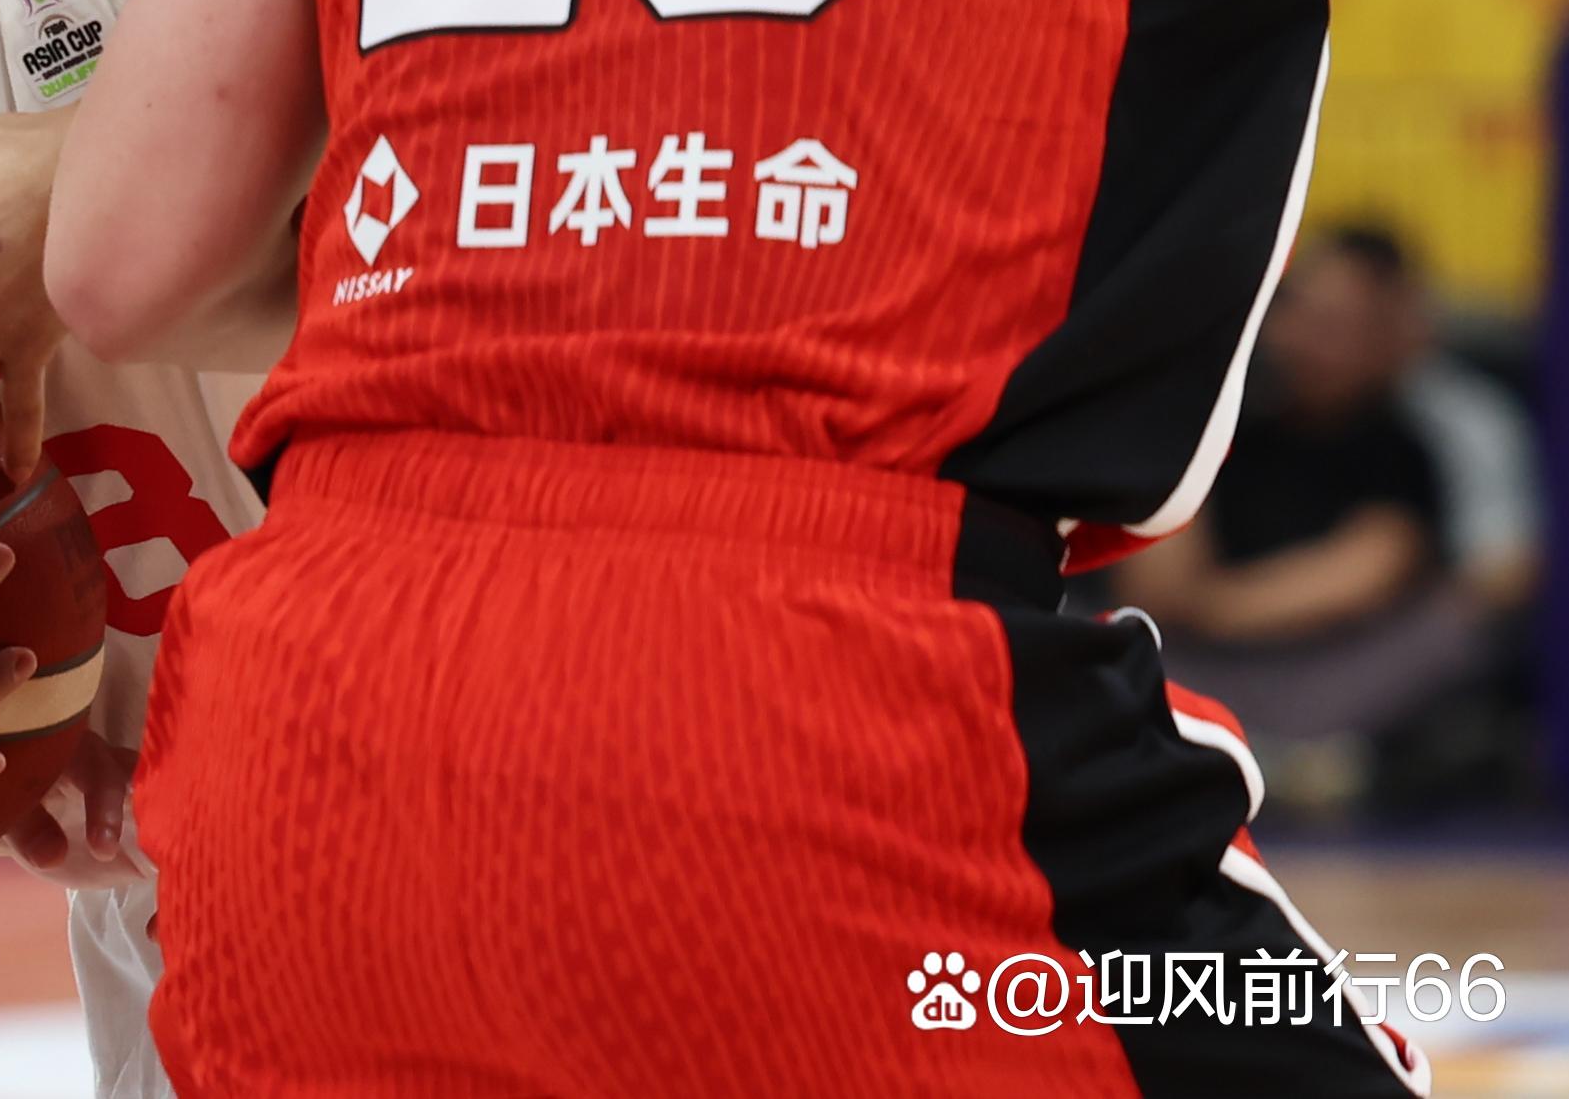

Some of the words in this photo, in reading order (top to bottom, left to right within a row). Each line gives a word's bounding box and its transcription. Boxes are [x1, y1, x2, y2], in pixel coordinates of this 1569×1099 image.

[22, 38, 70, 75] ASIA
[66, 20, 102, 52] CUP
[456, 131, 858, 249] 日本生命
[333, 267, 414, 306] NISSAY
